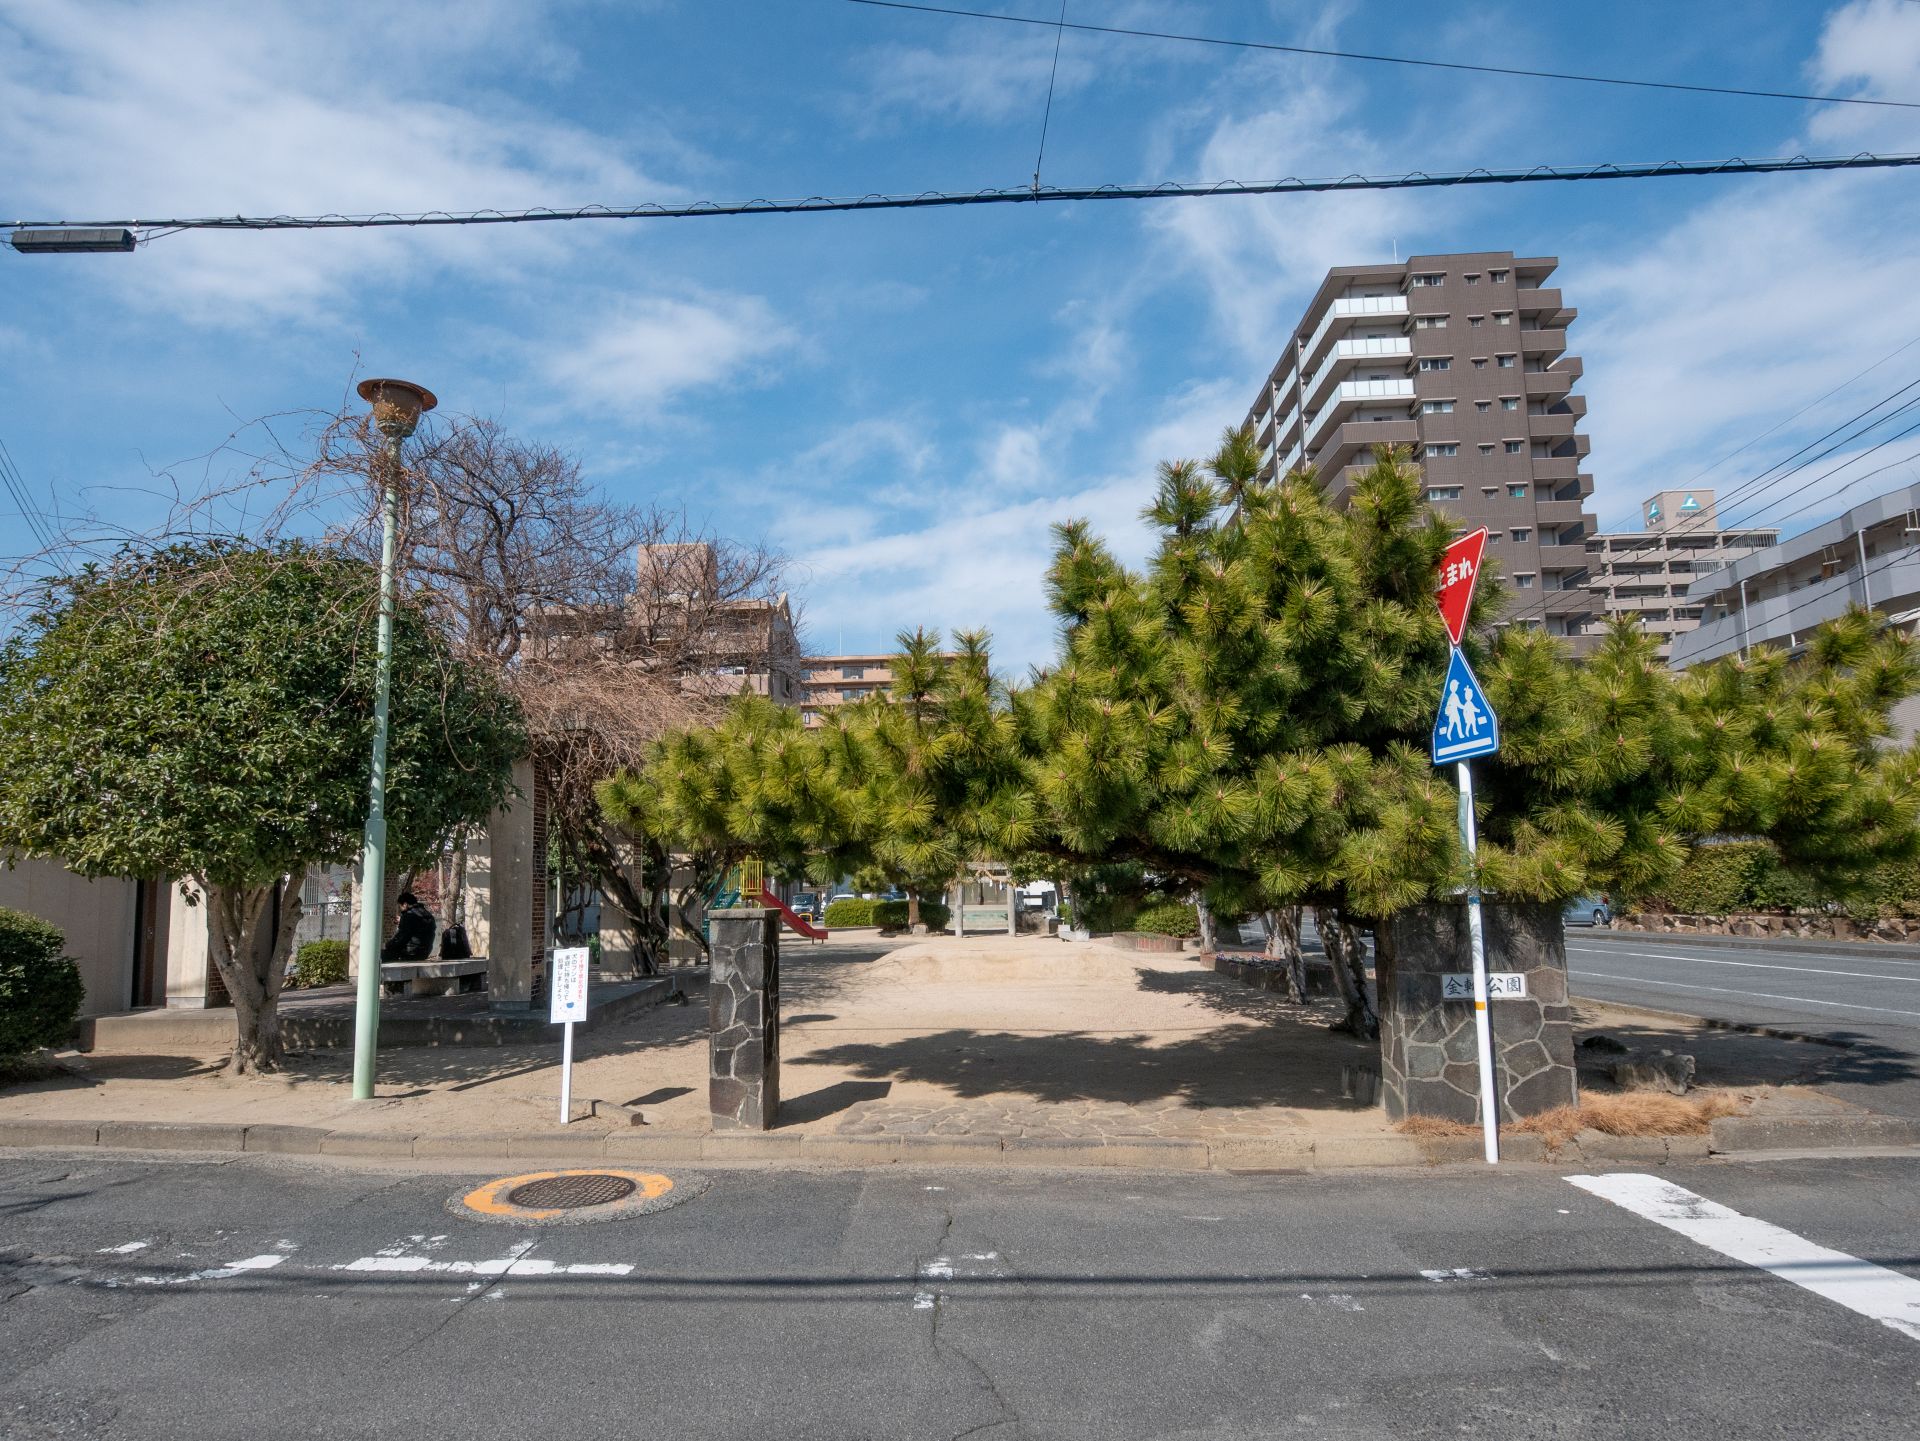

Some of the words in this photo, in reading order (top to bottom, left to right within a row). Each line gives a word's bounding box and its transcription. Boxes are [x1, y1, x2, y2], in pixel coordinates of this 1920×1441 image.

[570, 953, 578, 983] 犬のフンは
